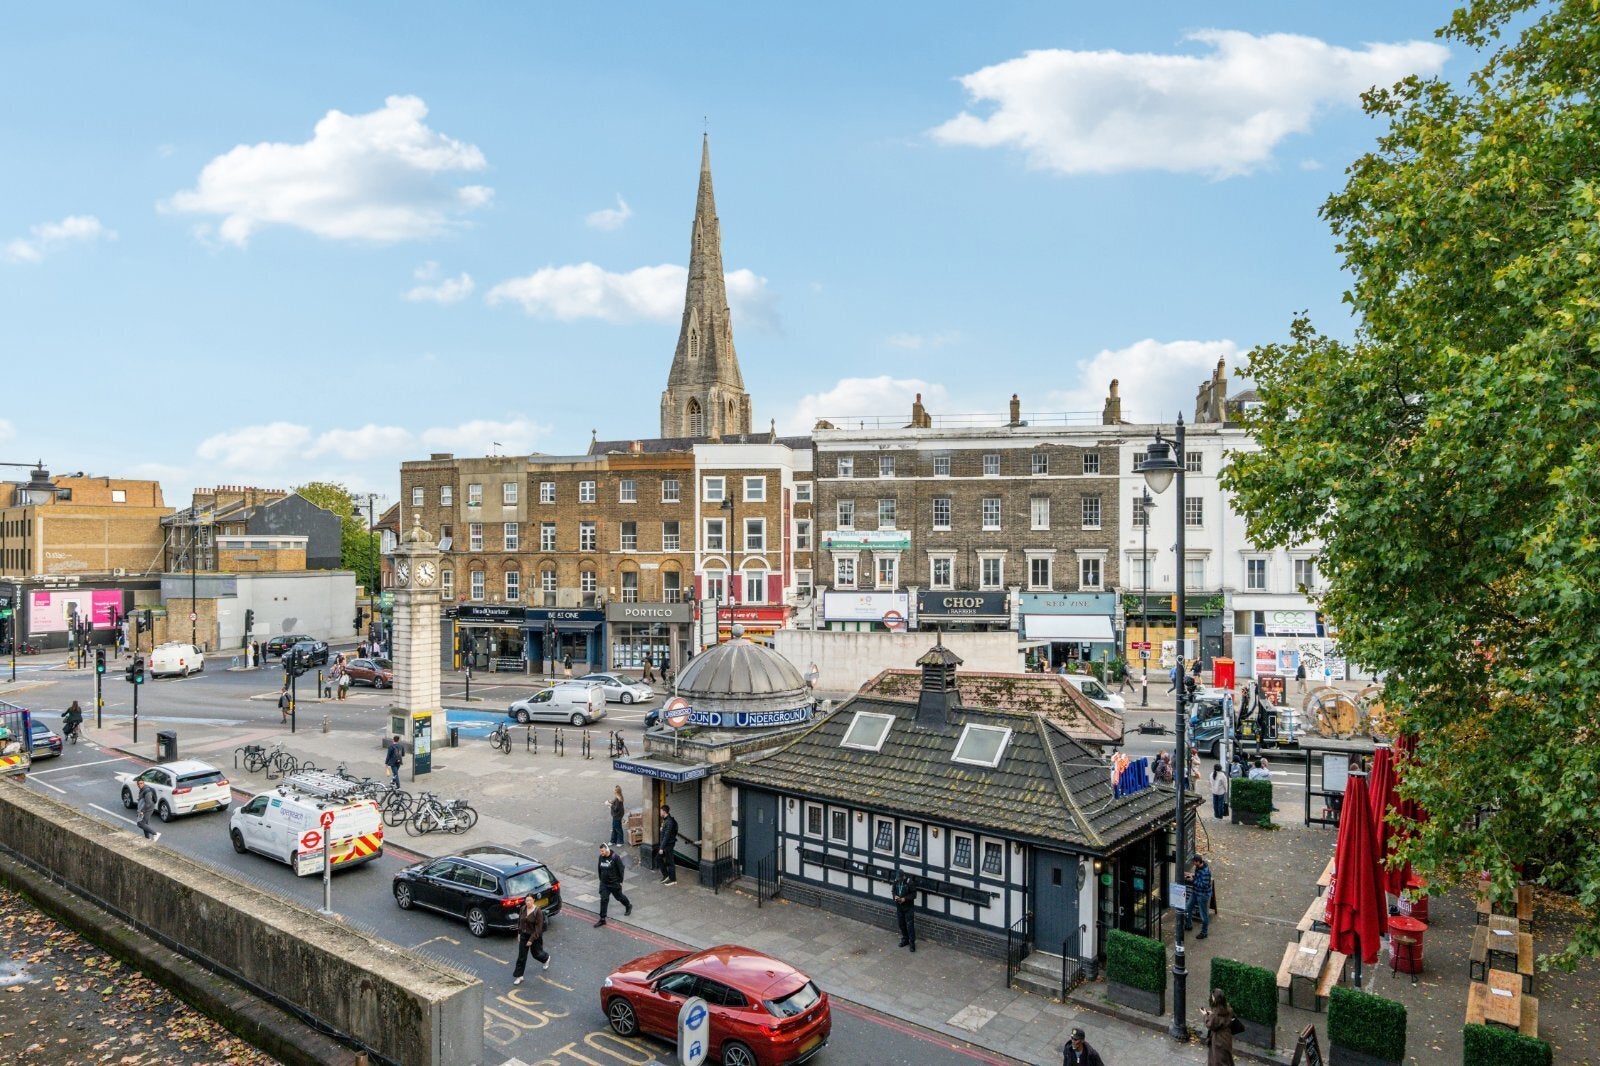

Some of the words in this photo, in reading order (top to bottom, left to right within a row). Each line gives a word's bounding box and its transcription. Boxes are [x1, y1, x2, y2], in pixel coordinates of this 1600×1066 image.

[942, 597, 985, 608] CHOP
[625, 608, 673, 617] PORTICO
[736, 709, 806, 726] UNDERGROUND
[614, 762, 634, 772] CLAPHAM
[636, 766, 657, 776] COMMON
[660, 771, 678, 780] STATION
[324, 813, 332, 825] A
[484, 988, 570, 1045] BUS
